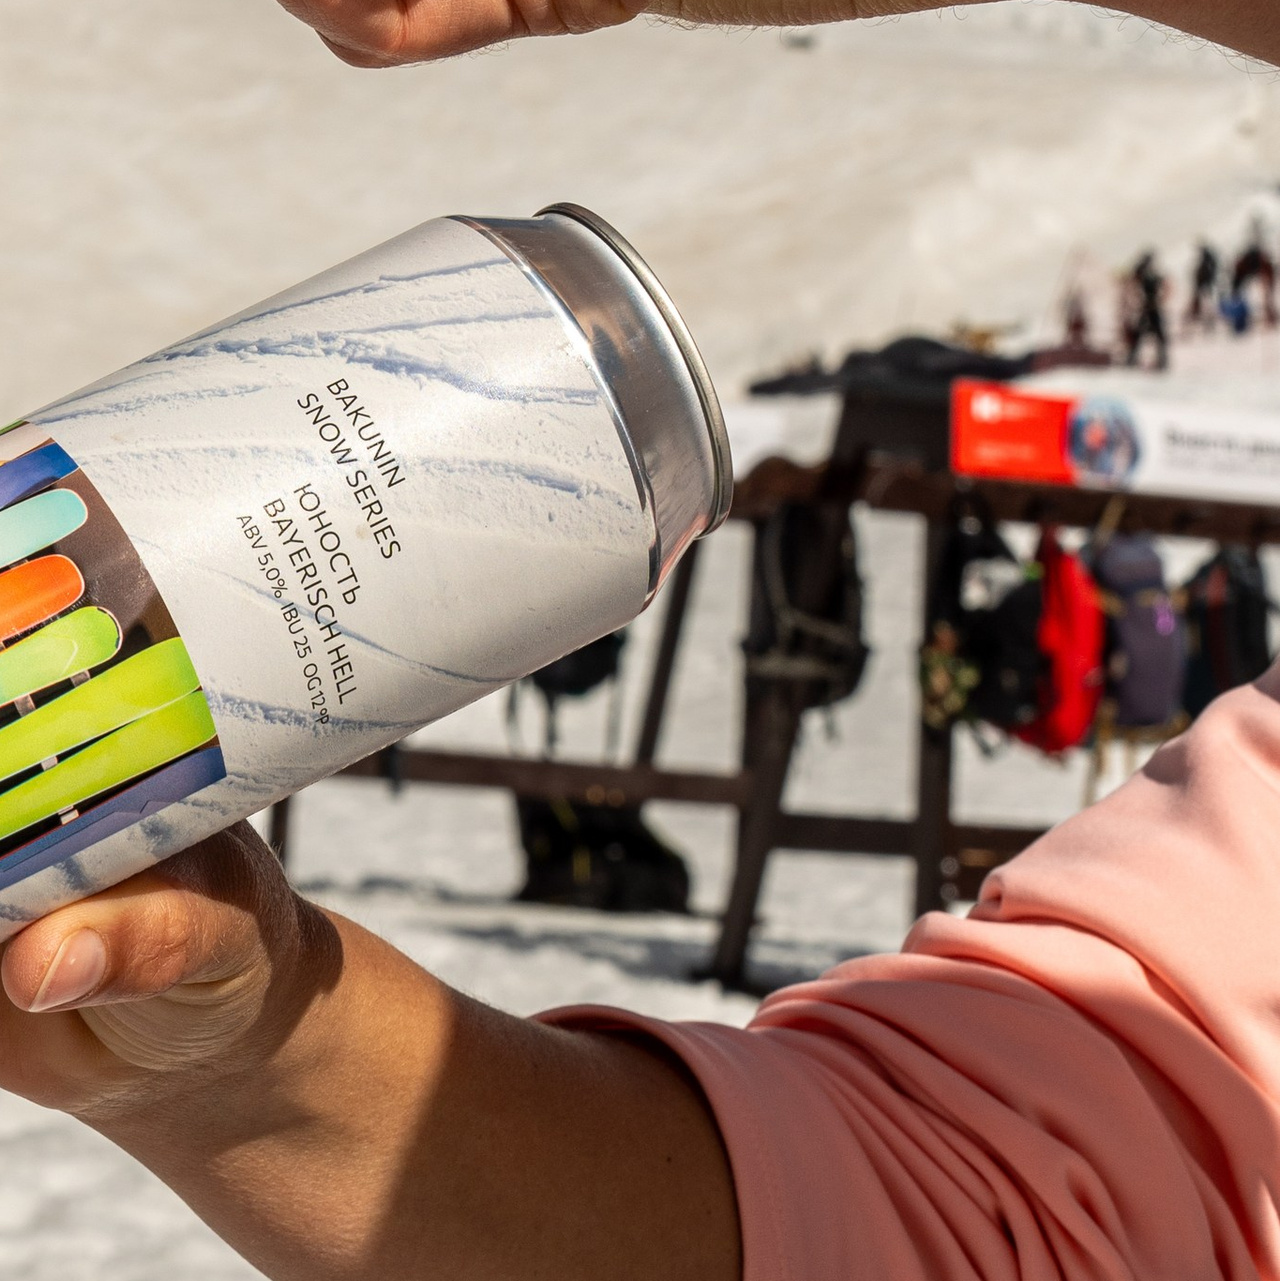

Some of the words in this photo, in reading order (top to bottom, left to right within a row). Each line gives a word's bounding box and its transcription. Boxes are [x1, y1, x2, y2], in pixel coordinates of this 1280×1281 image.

[297, 393, 357, 465] SNOW
[346, 470, 401, 559] SERIES
[326, 378, 405, 490] BAKUNIN
[236, 515, 267, 549] ABV
[258, 553, 288, 599] 5,0%
[281, 602, 304, 634] IBU
[293, 636, 312, 659] 25
[303, 663, 322, 691] OG
[263, 498, 342, 642] BAYERISCH
[327, 644, 357, 705] HELL
